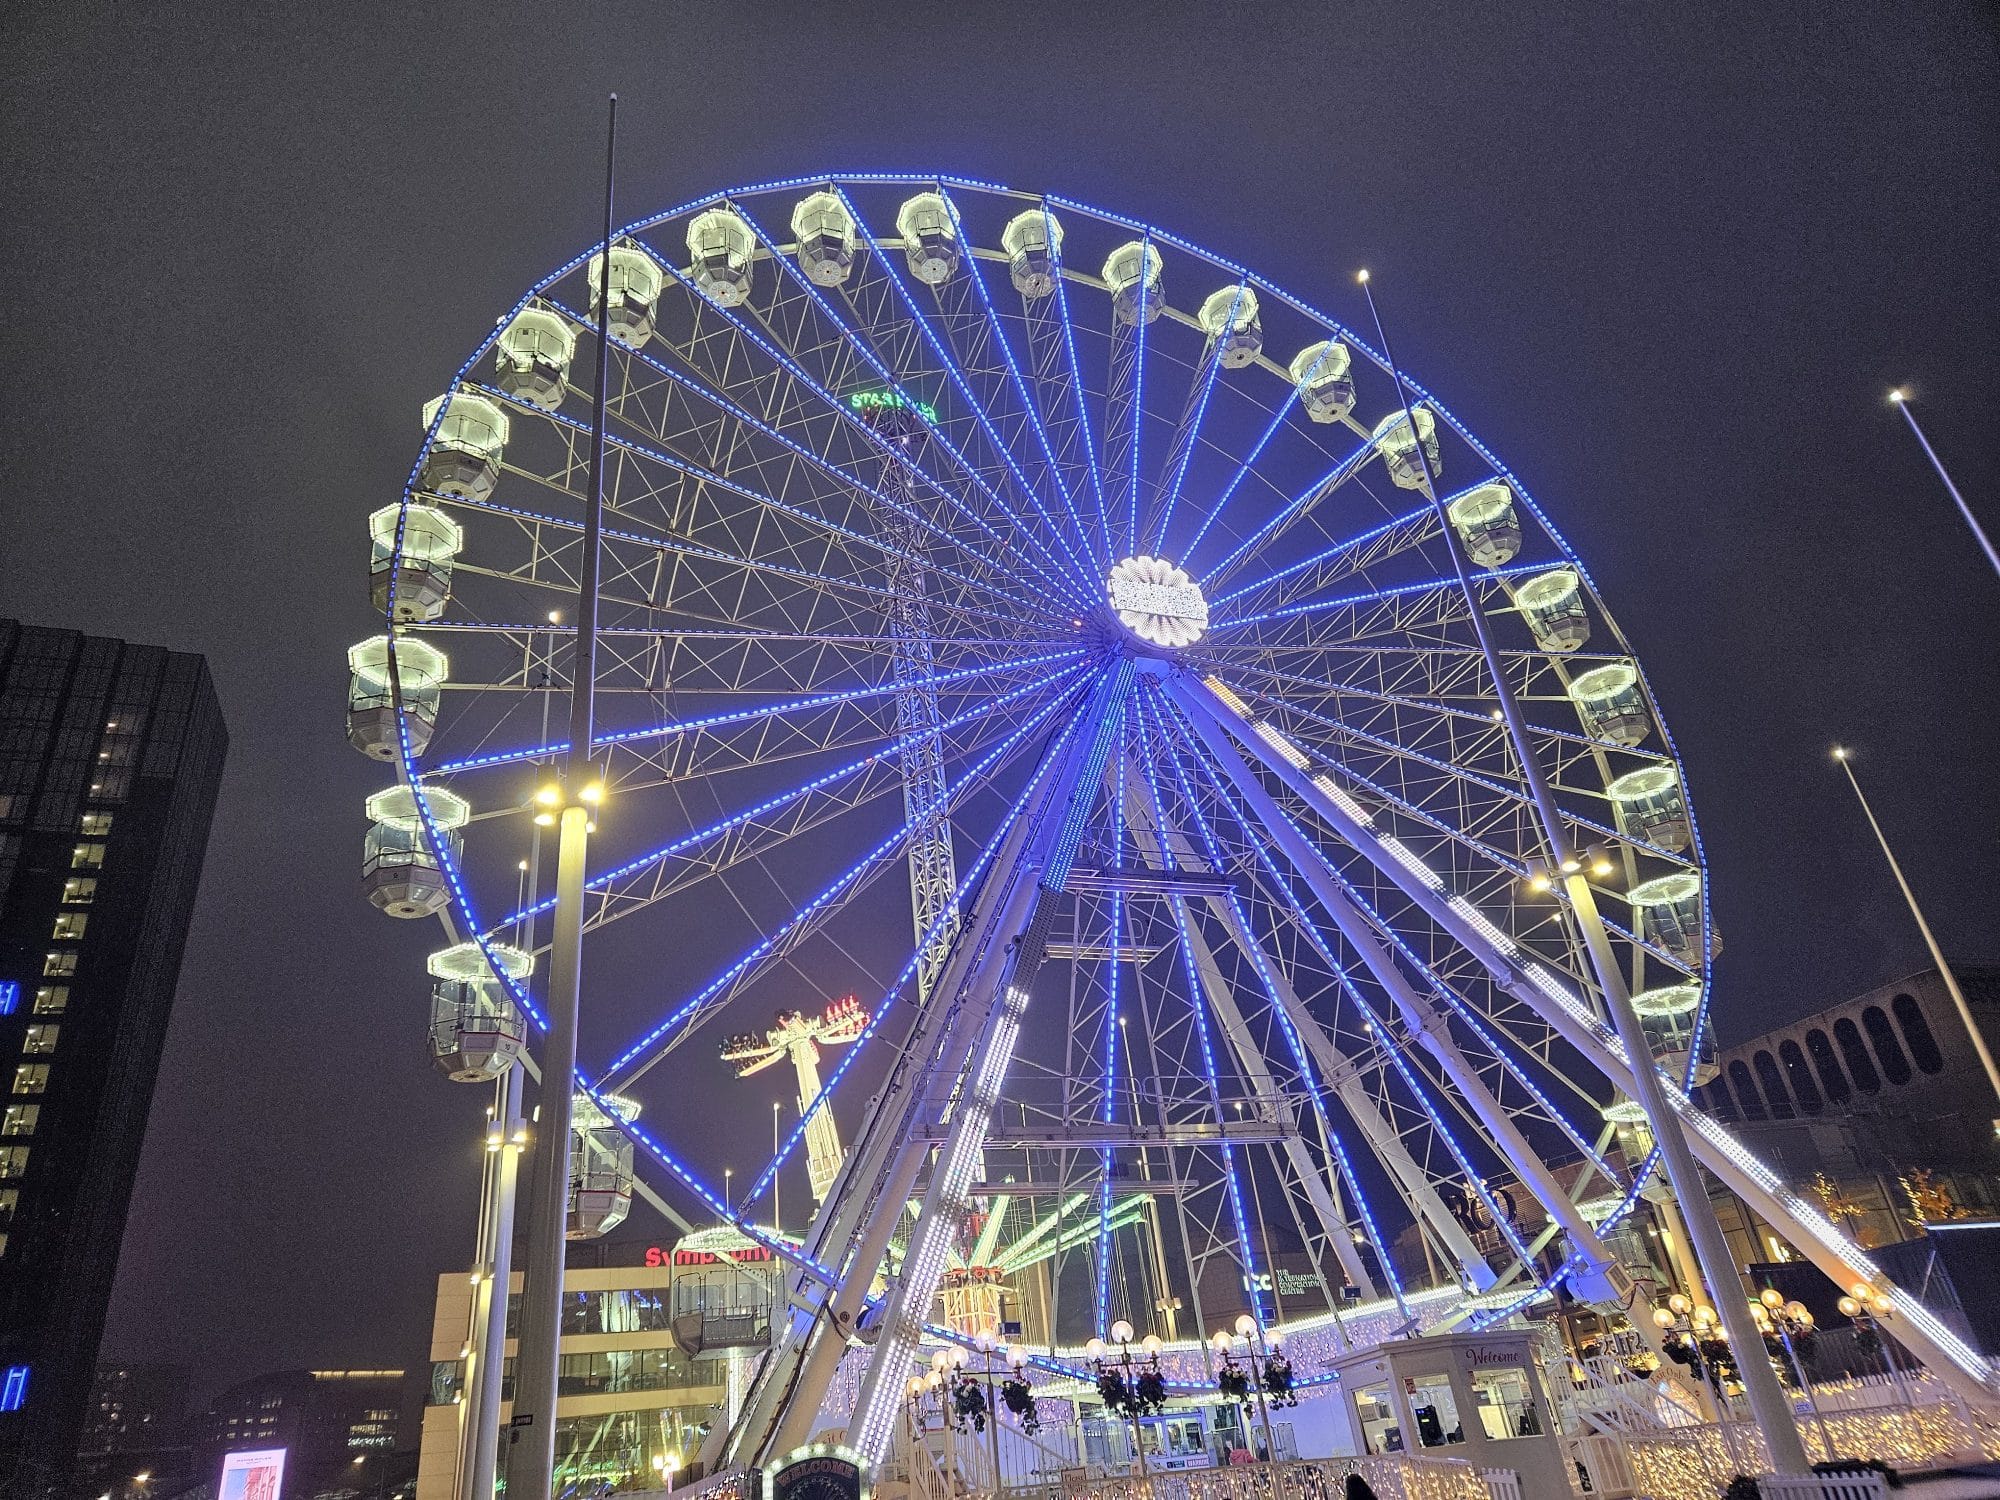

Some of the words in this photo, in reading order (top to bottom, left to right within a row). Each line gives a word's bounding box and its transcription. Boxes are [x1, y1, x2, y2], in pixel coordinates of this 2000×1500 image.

[851, 392, 894, 408] STAR
[645, 1246, 772, 1267] Sympony
[1466, 1346, 1520, 1366] Welcome
[776, 1460, 856, 1487] WELCOME
